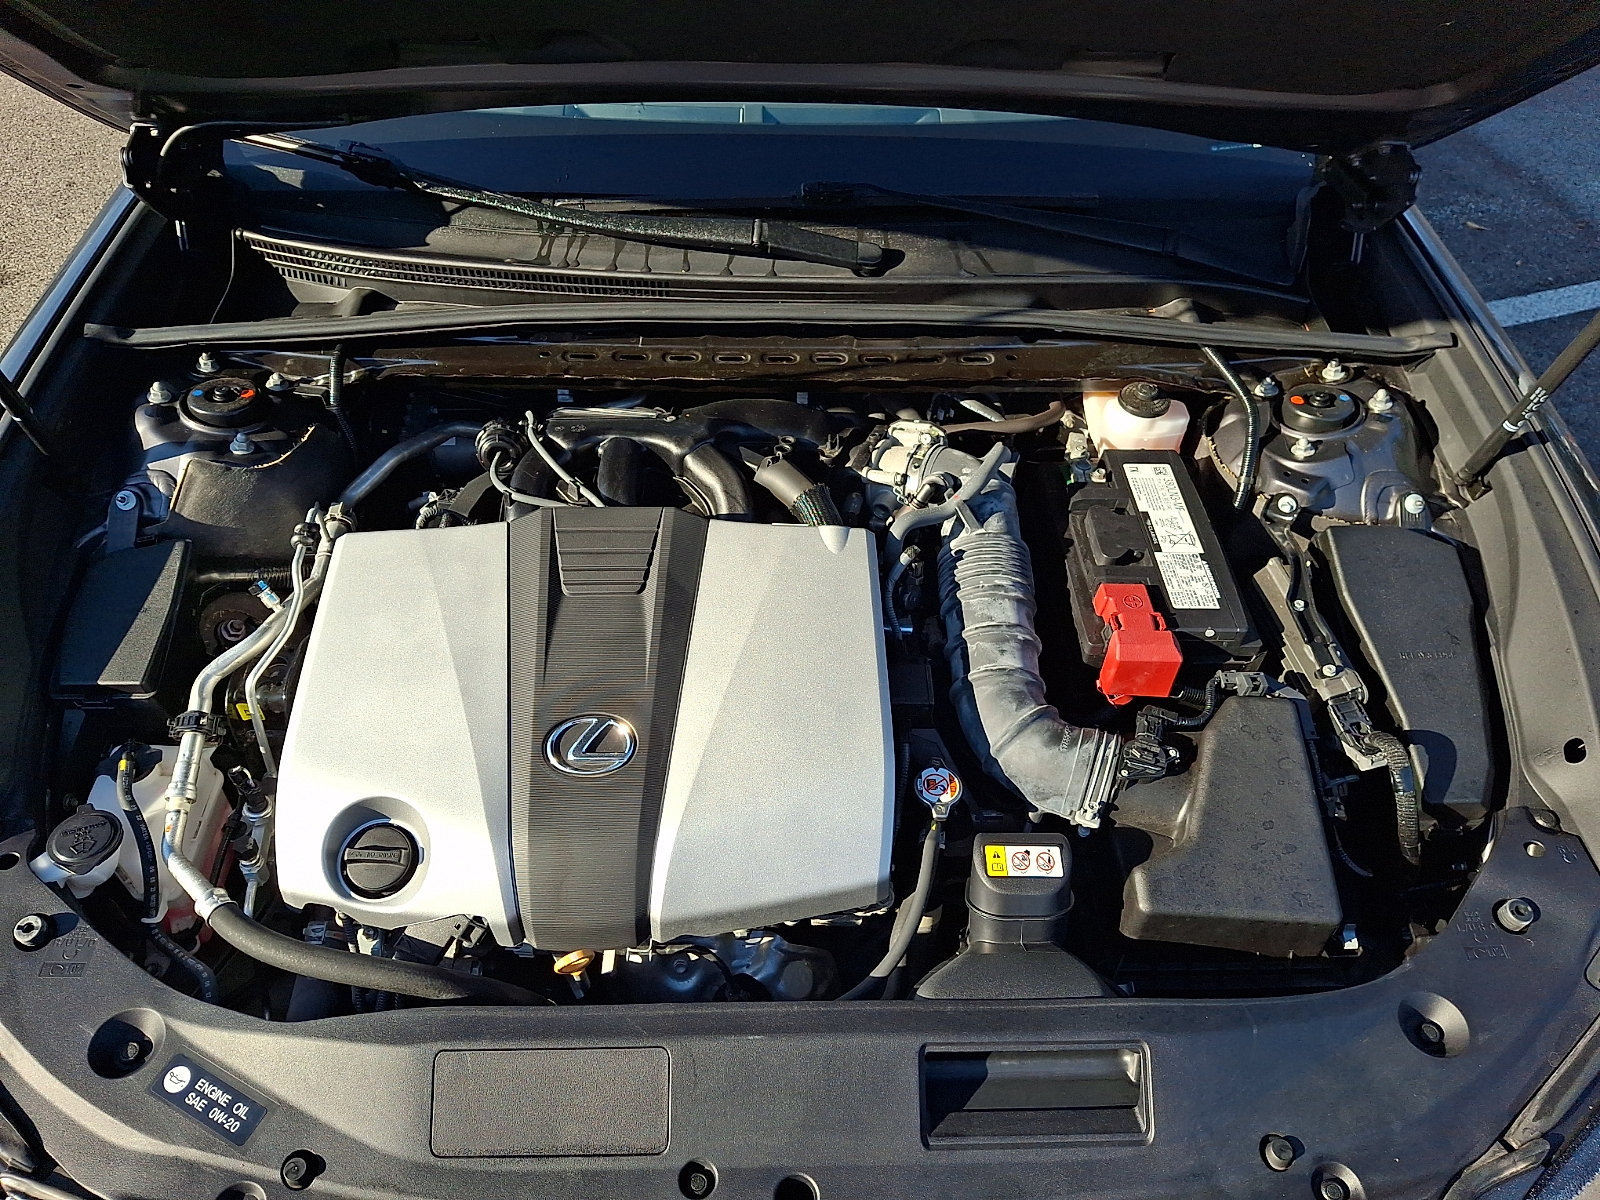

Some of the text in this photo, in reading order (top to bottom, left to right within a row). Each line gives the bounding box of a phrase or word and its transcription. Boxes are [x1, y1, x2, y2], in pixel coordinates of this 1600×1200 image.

[184, 1092, 240, 1133] SAE 0W-20
[194, 1078, 251, 1120] ENGINE OIL
